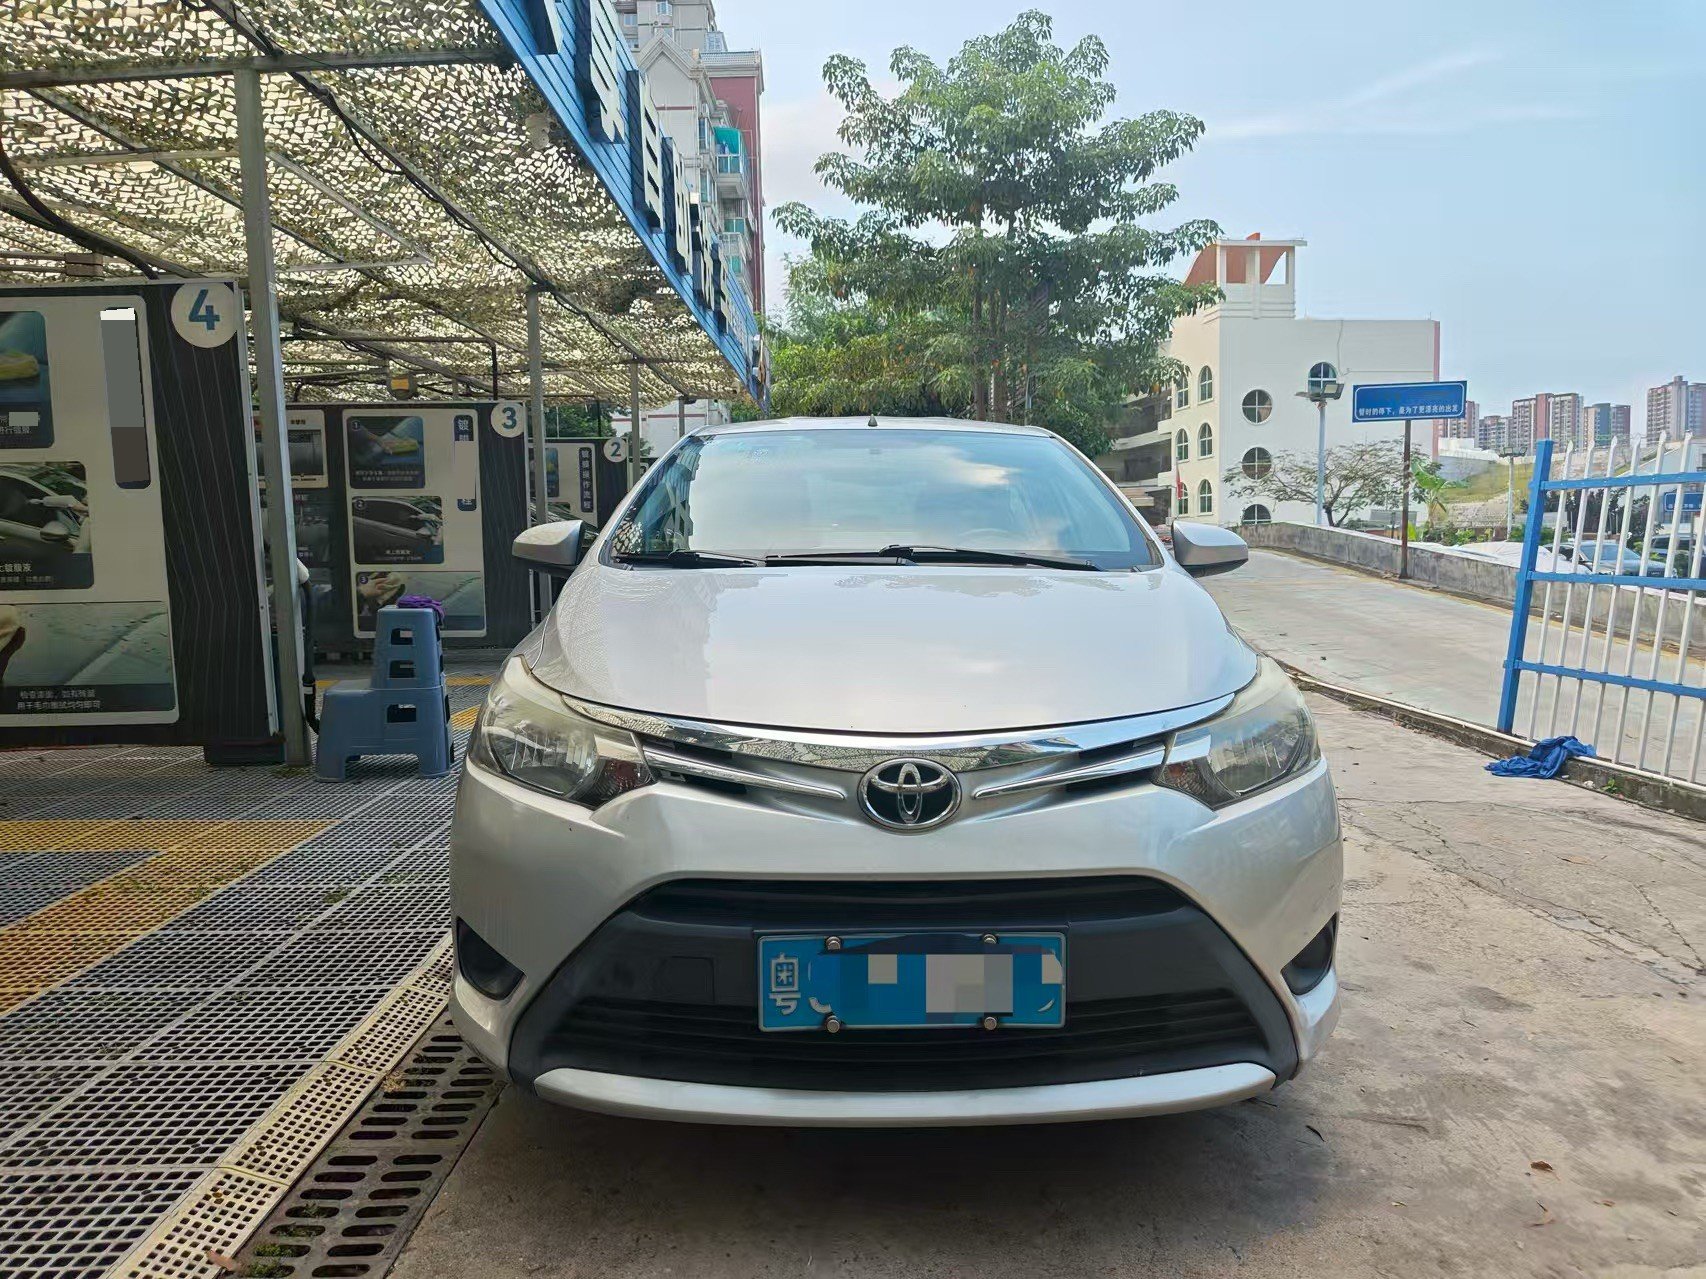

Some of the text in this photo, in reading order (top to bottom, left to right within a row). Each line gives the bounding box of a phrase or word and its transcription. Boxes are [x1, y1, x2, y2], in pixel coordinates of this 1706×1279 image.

[187, 288, 222, 332] 4
[501, 406, 518, 430] 3
[610, 441, 622, 457] 2
